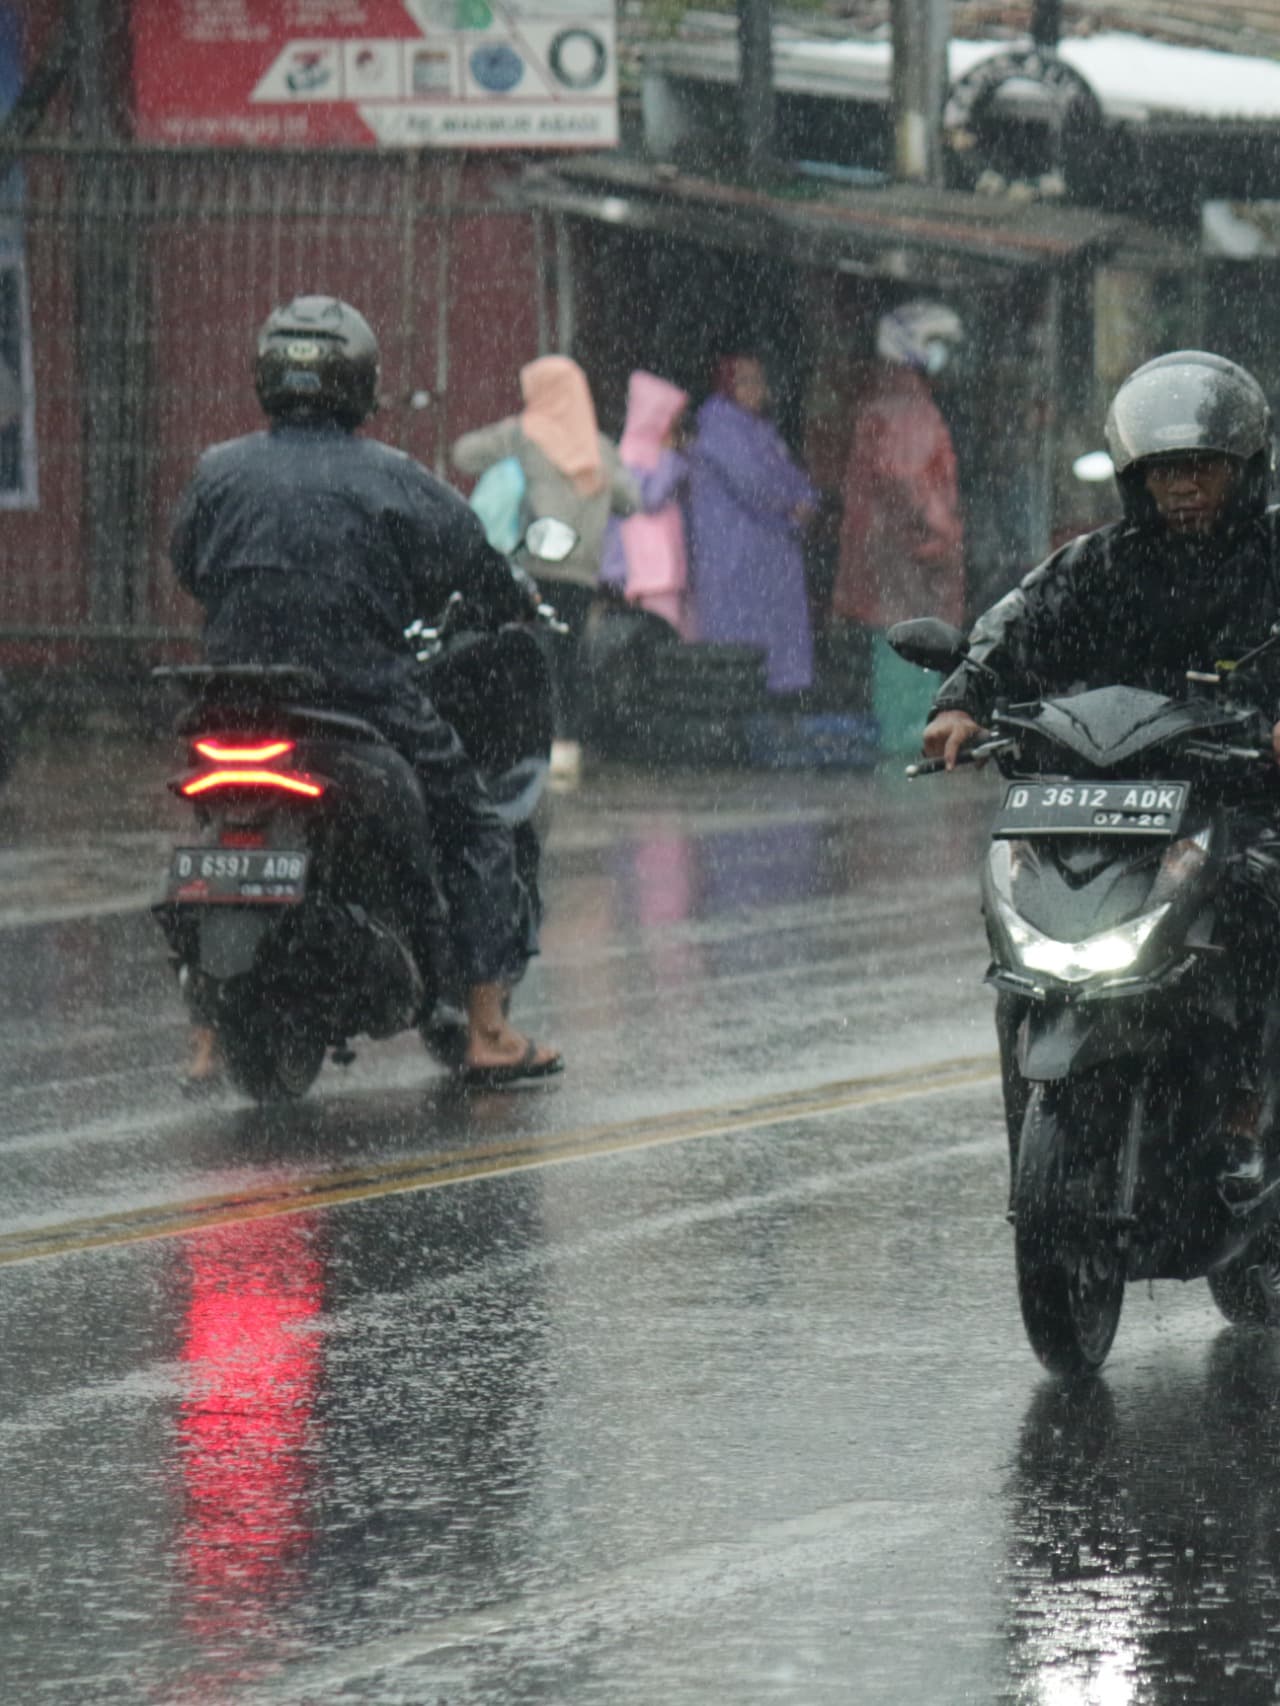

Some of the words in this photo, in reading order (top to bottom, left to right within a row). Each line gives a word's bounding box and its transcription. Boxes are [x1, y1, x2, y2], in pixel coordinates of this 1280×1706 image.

[1011, 789, 1029, 808] D
[1041, 788, 1108, 808] 3612
[1123, 790, 1177, 809] ADK
